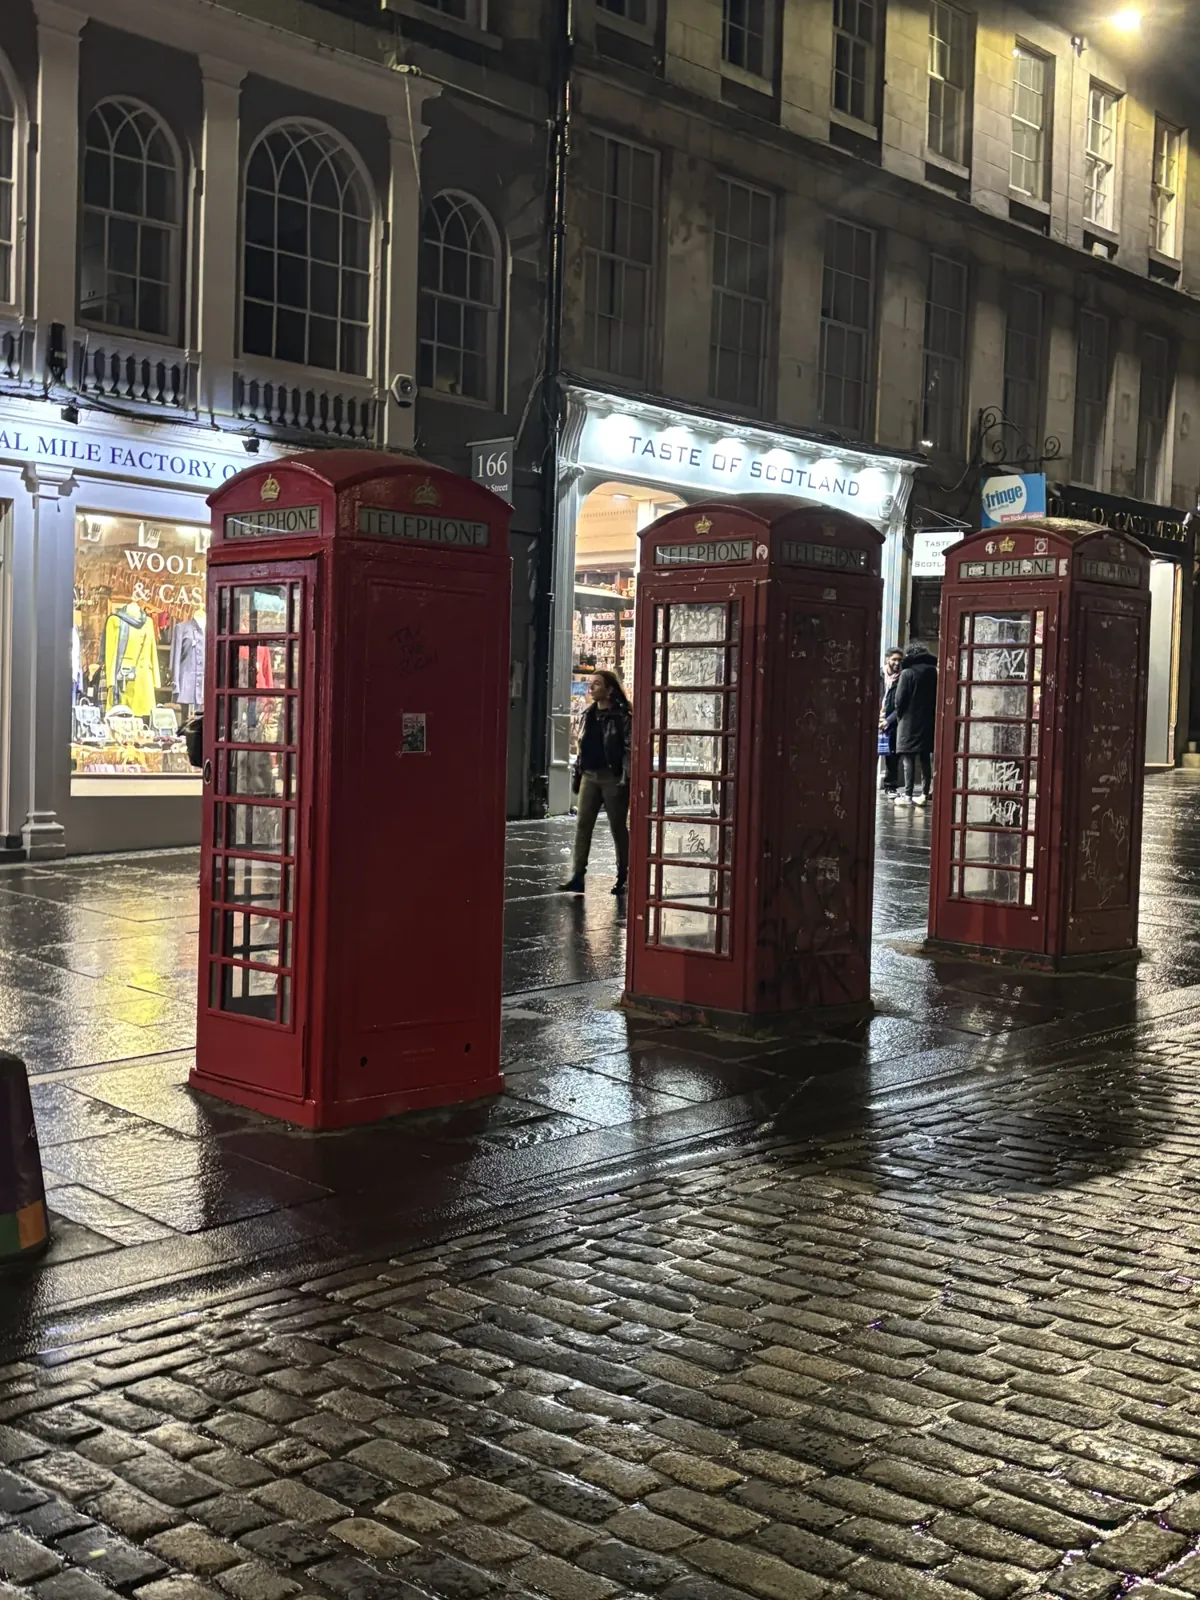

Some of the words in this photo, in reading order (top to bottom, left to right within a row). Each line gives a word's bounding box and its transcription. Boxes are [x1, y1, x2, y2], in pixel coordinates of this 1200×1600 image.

[37, 436, 101, 462] MILE
[109, 446, 217, 479] FACTORY
[477, 451, 508, 478] 166
[628, 436, 702, 467] TASTE
[711, 453, 743, 474] OF
[749, 460, 860, 497] SCOTLAND
[984, 485, 1024, 509] fringe
[229, 508, 318, 536] TELEPHONE
[363, 510, 483, 546] TELEPHONE
[124, 549, 207, 581] WOOL,
[659, 541, 750, 564] TELEPHONE
[131, 582, 151, 602] &
